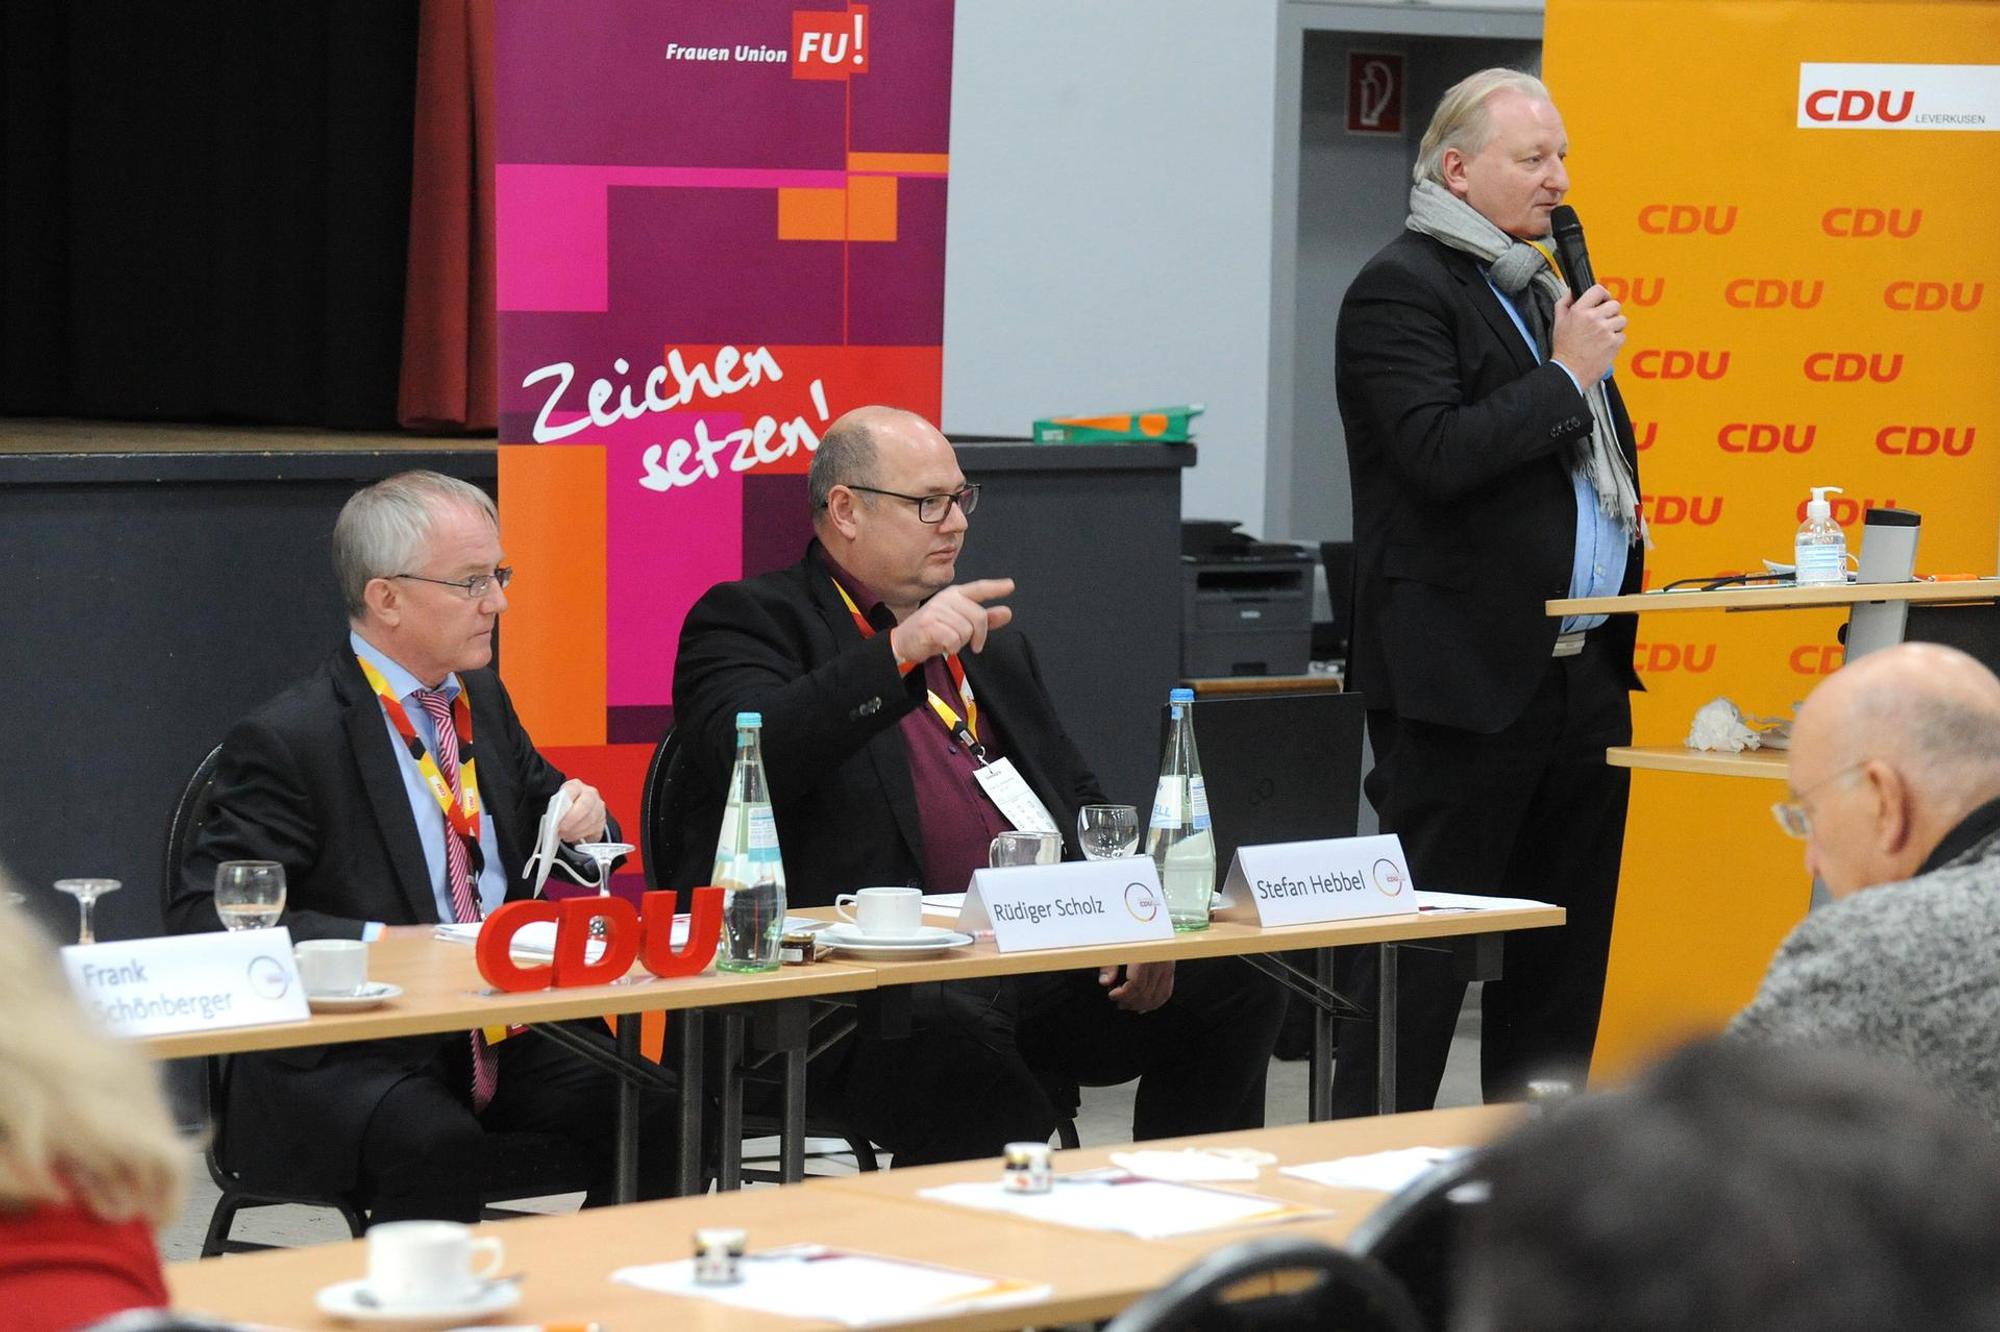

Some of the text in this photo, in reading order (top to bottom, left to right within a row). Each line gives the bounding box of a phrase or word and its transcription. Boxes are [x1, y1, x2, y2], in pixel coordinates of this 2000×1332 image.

[665, 43, 787, 63] Frauen Union
[798, 14, 863, 65] FU!
[1805, 89, 1915, 122] CDU
[1915, 113, 1986, 124] LEVERKUSEN
[1637, 204, 1738, 236] CDU
[1821, 207, 1923, 239] CDU
[1598, 276, 1665, 307] DU
[1724, 278, 1825, 310] CDU
[1883, 281, 1985, 313] CDU
[1630, 349, 1731, 381] CDU
[1802, 352, 1904, 384] CDU
[522, 345, 783, 444] Zeichen
[638, 379, 830, 492] setzen!
[1717, 423, 1817, 455] CDU
[1875, 425, 1977, 457] CDU
[1788, 645, 1845, 675] CD
[1257, 869, 1366, 900] Stefan Hebbel
[994, 895, 1105, 924] Rüdiger Scholz
[475, 887, 725, 993] CDU
[81, 957, 149, 988] Frank
